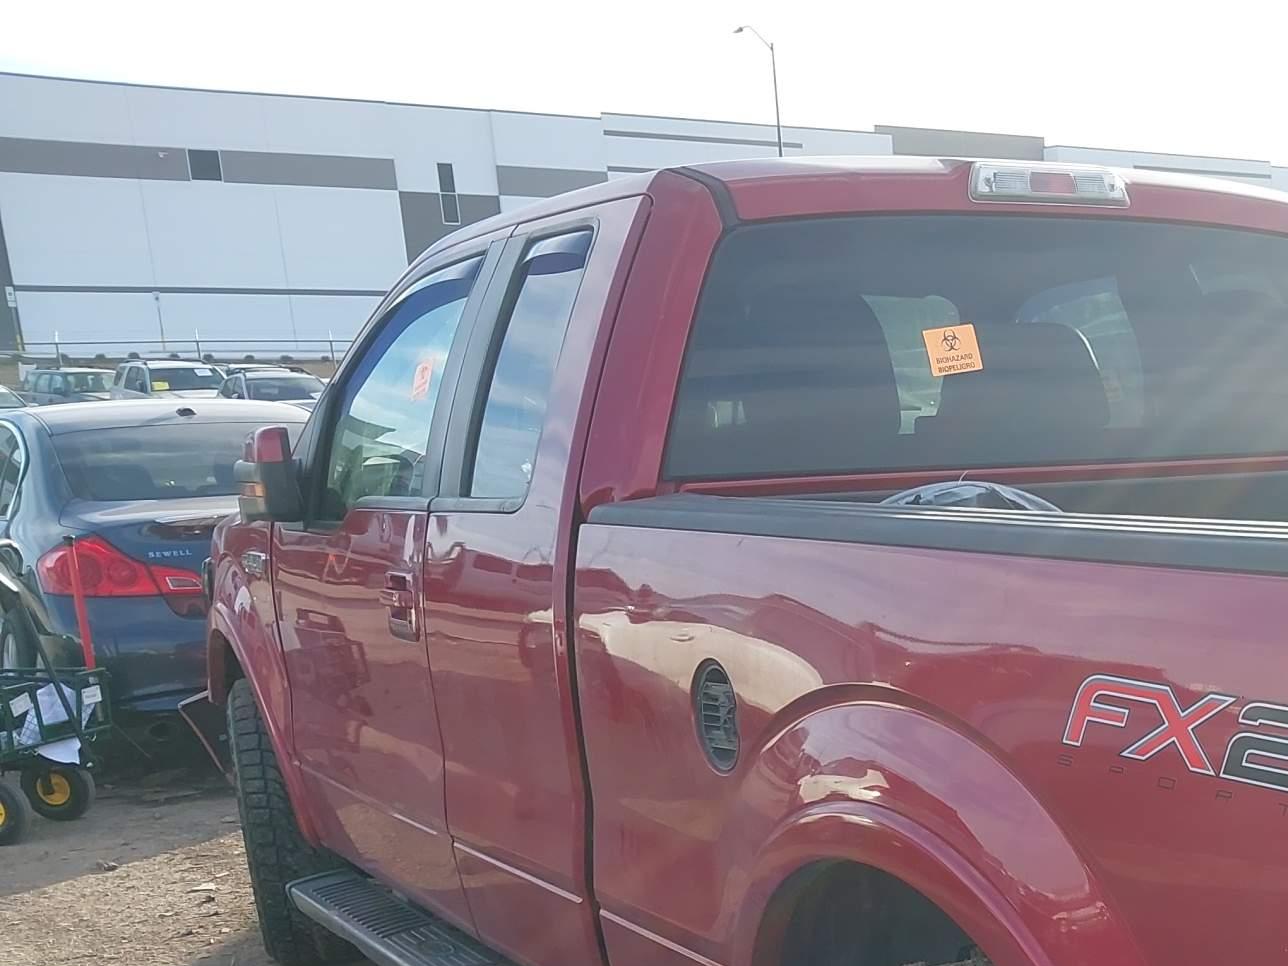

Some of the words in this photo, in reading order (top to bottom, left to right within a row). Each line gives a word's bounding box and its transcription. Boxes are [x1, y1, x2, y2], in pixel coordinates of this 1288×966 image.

[936, 353, 973, 364] BIOHAZARD
[938, 361, 976, 373] BIOPELIGRO
[148, 549, 193, 558] SEWELL
